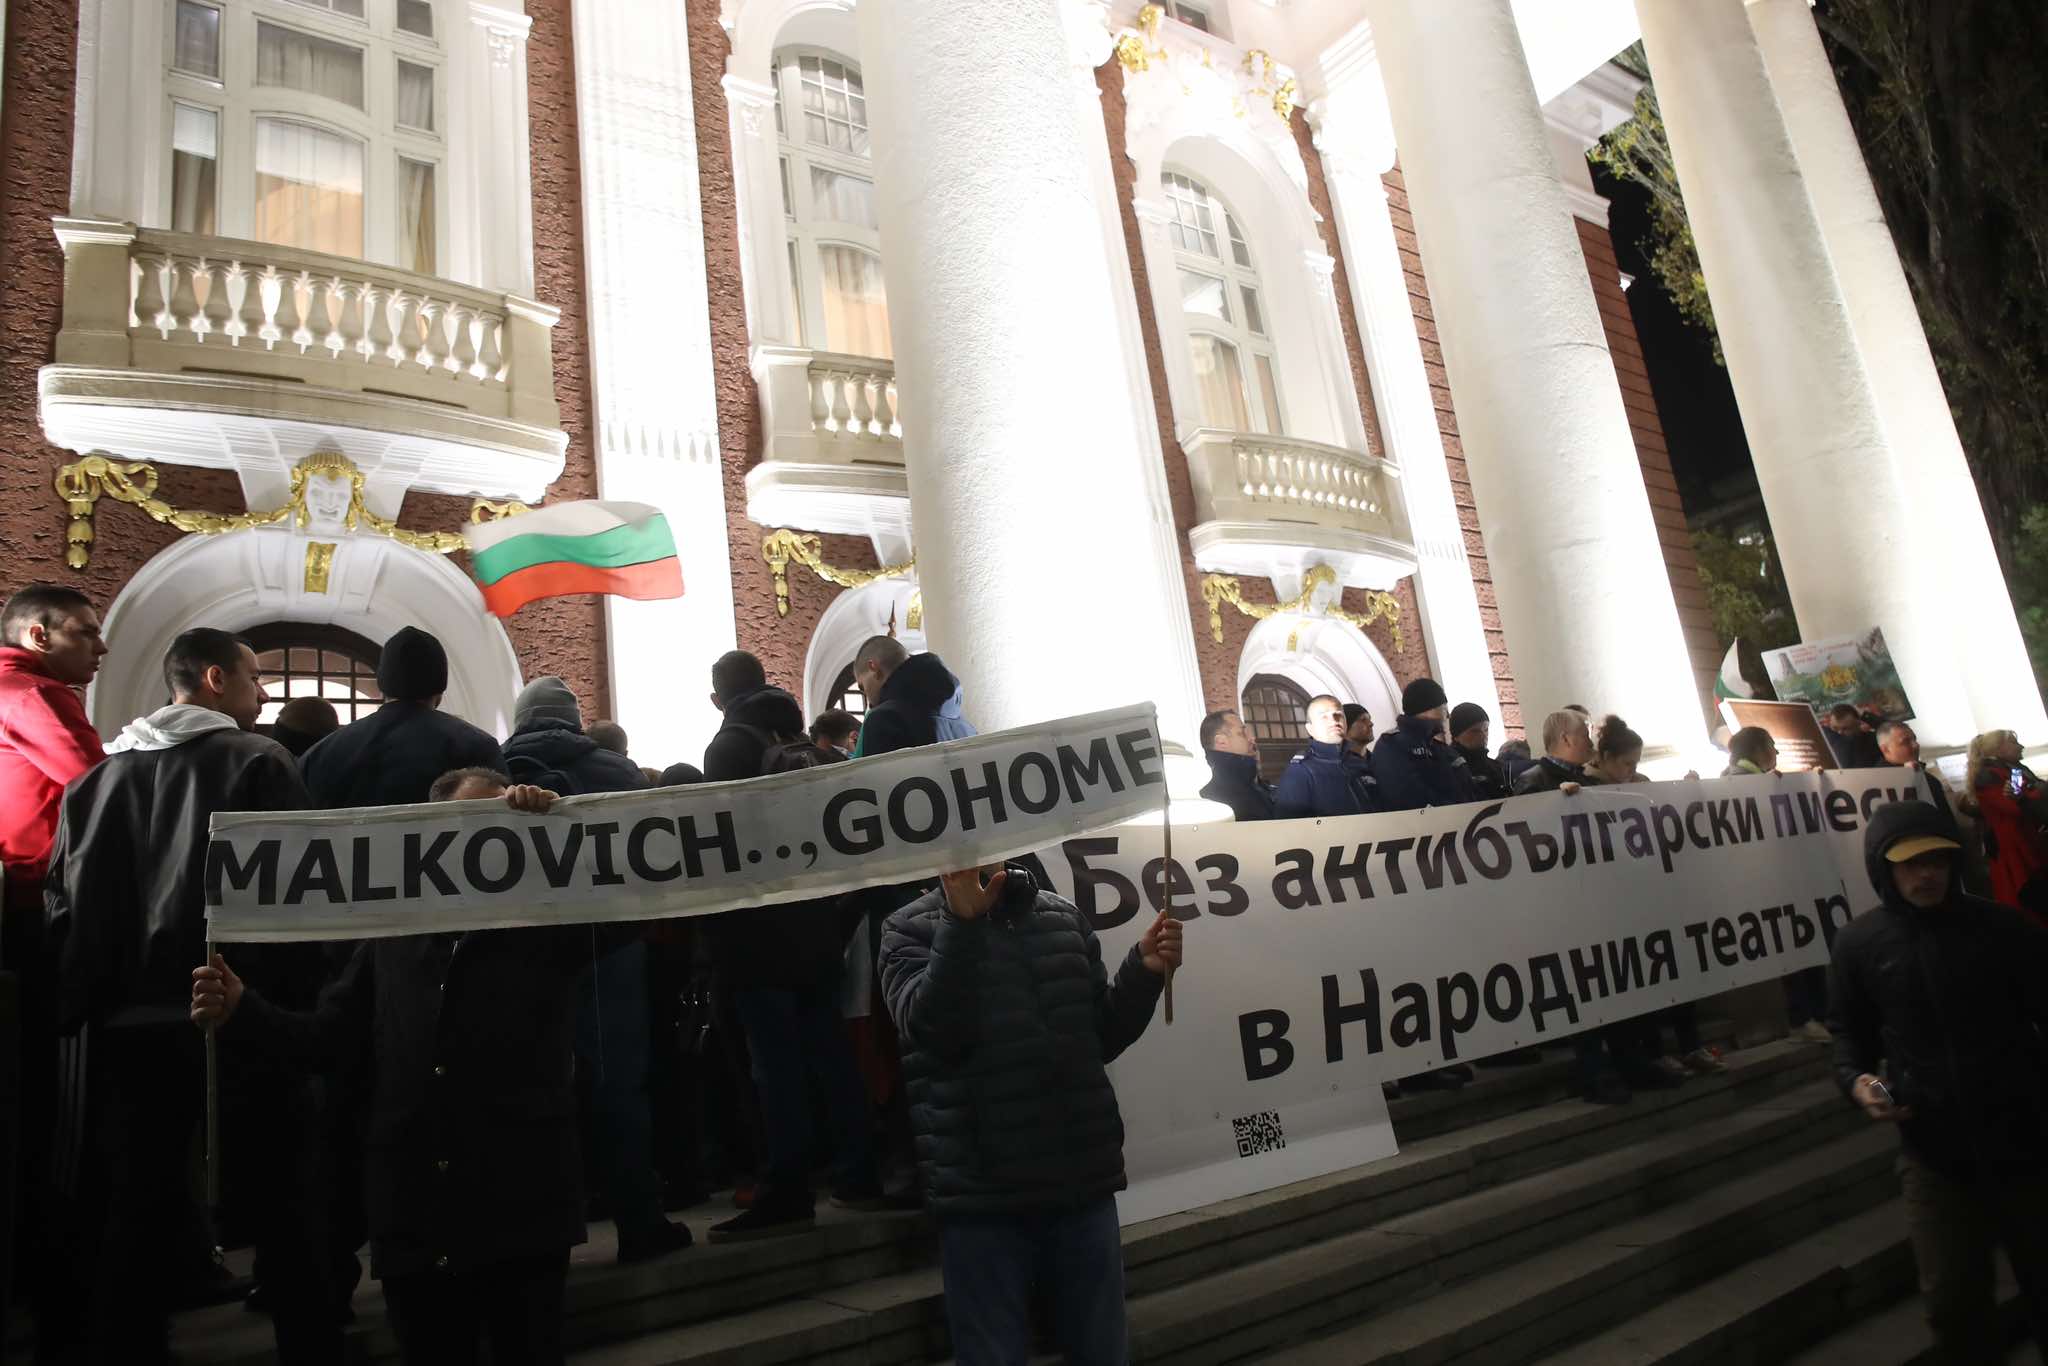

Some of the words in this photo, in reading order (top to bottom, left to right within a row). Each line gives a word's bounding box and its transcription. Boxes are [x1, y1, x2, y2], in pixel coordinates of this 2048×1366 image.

[1062, 836, 1250, 931] Без
[1271, 801, 1764, 909] антибългарски
[1238, 1008, 1294, 1081] в
[1321, 929, 1679, 1063] Народния
